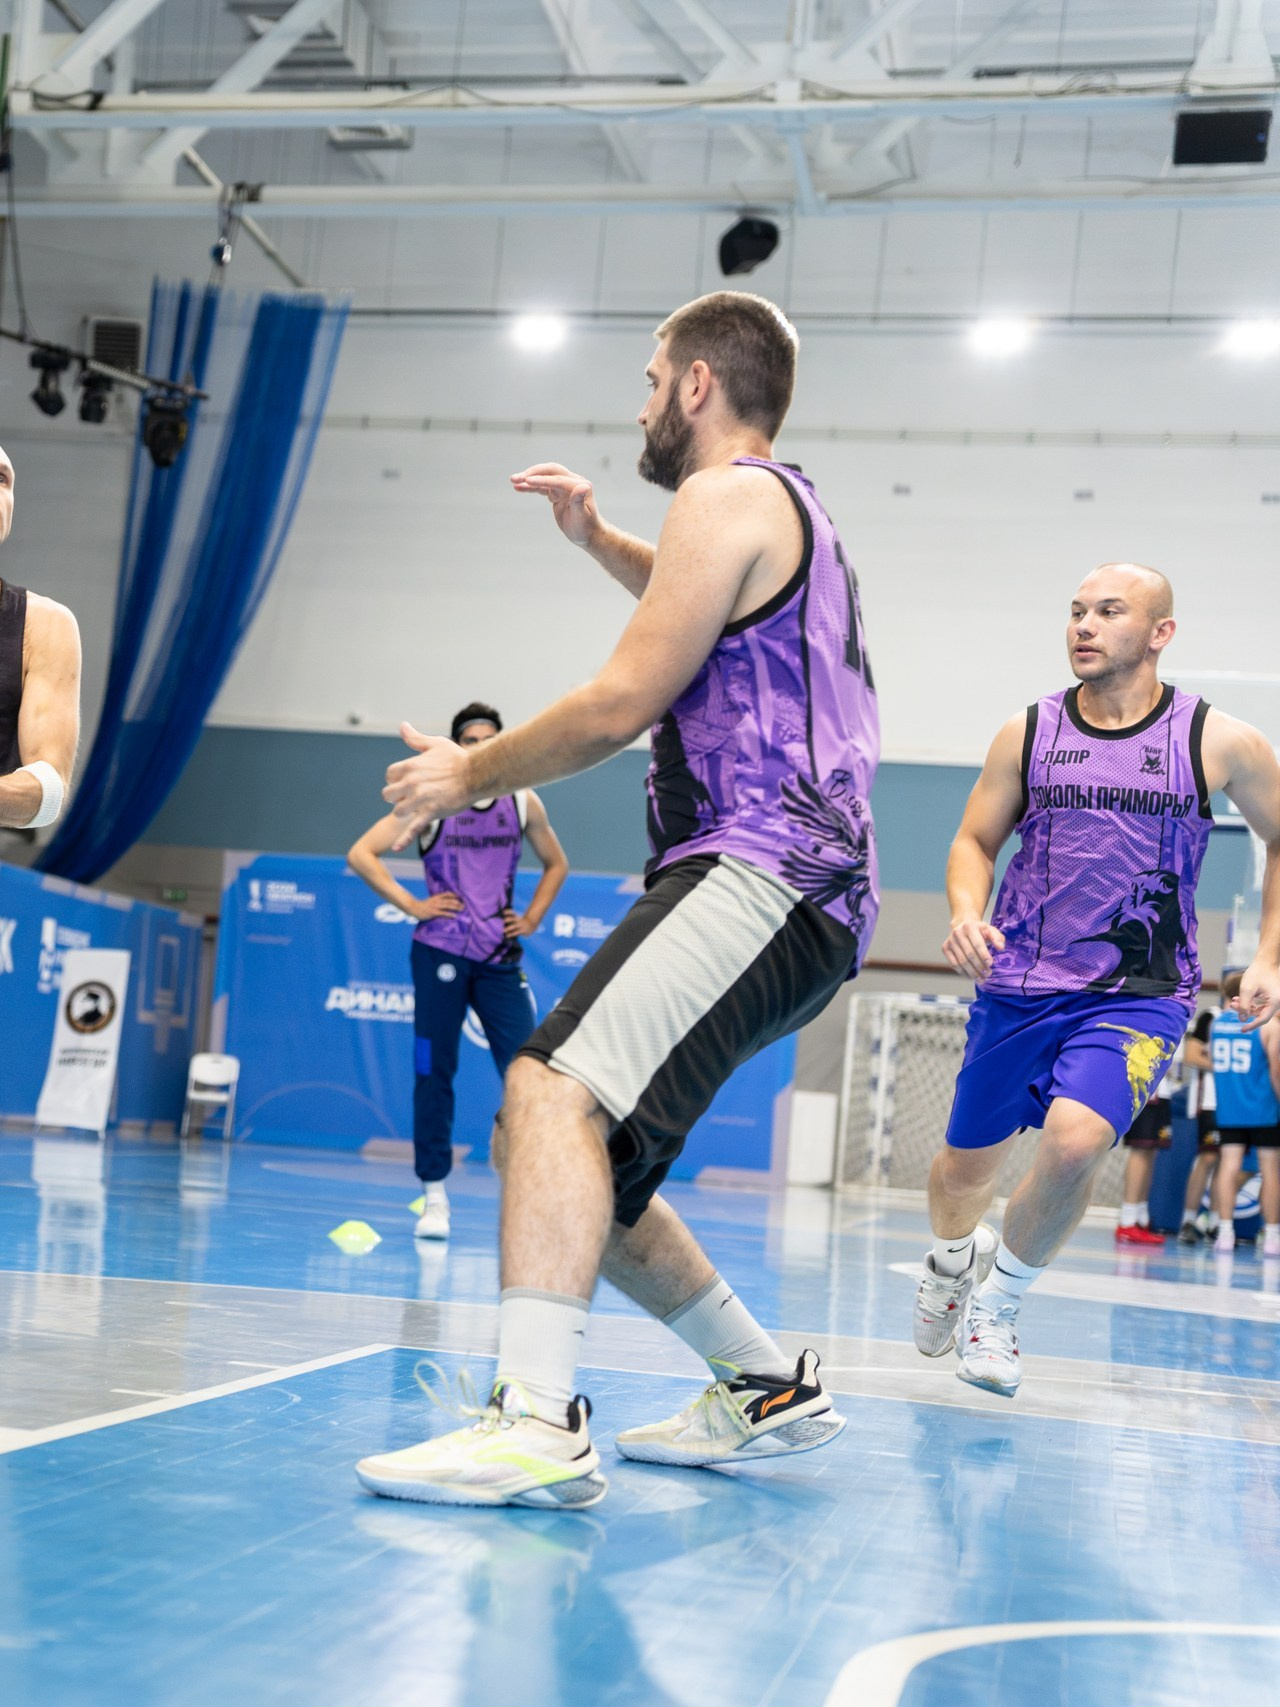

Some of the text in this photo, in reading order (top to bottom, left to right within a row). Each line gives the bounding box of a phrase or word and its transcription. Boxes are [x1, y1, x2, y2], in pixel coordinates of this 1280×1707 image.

[1040, 749, 1091, 766] ЛДПР
[1031, 785, 1195, 818] СОКОЛЫ ПРИМОРЬЯ
[1213, 1037, 1252, 1073] 95
